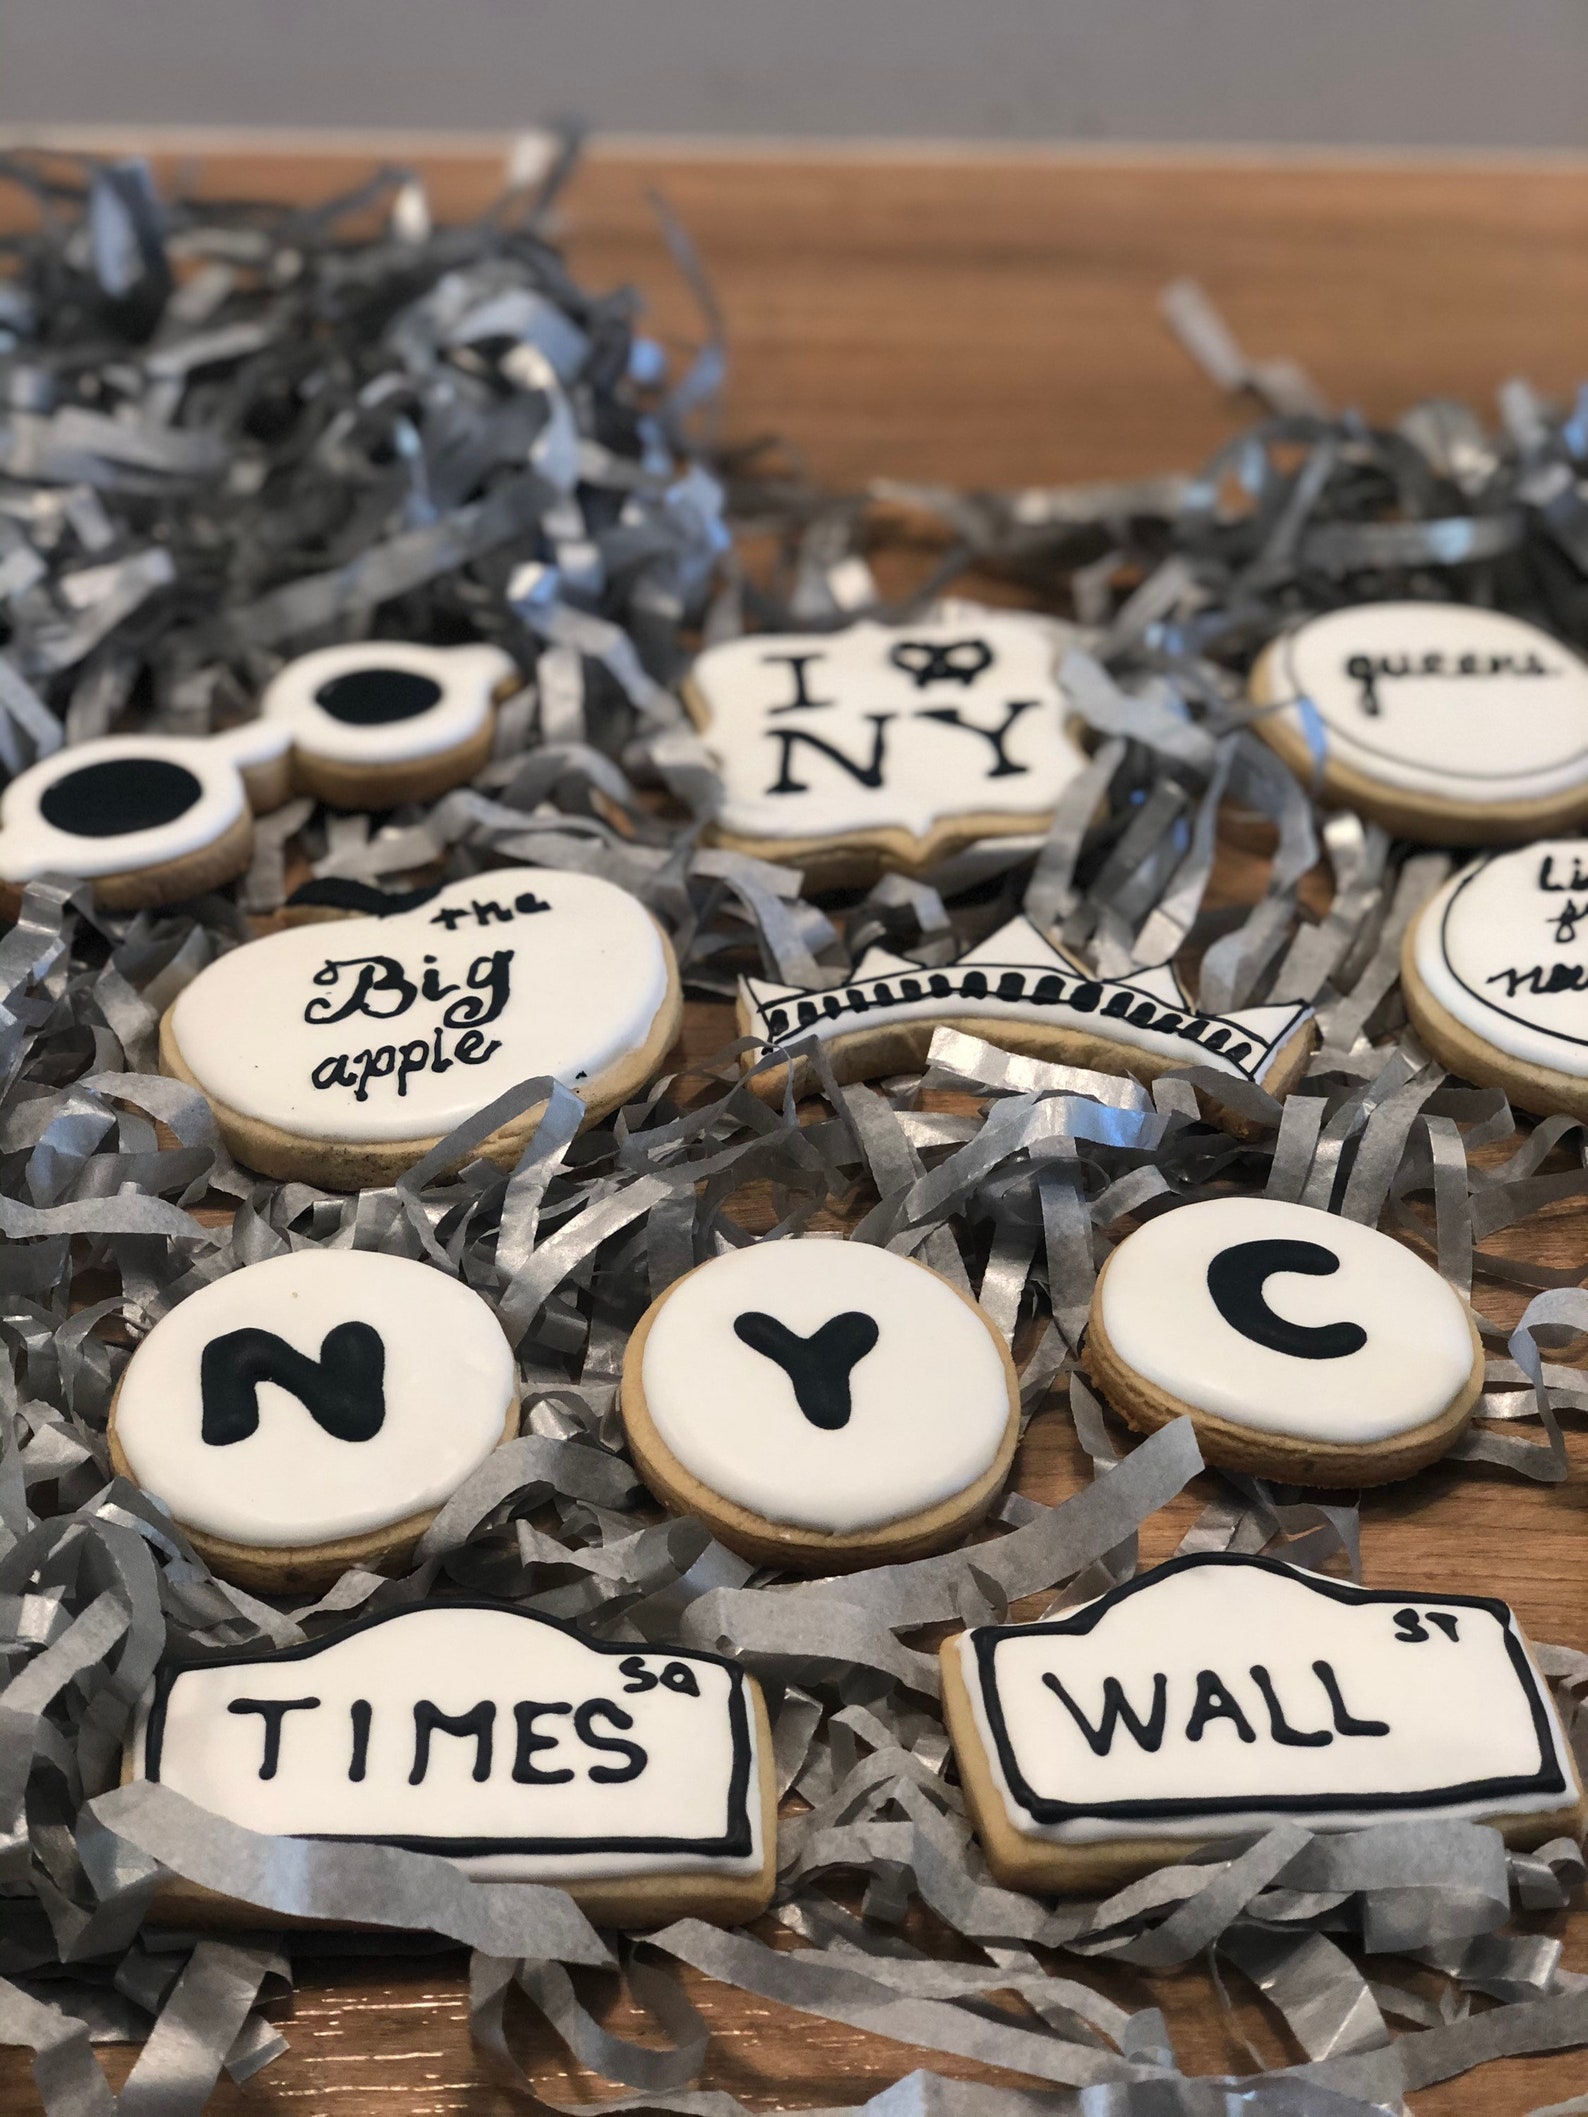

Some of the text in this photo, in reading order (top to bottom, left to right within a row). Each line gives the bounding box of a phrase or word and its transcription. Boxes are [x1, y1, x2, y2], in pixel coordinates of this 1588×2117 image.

[761, 652, 836, 716] I
[1344, 650, 1563, 718] queens
[763, 699, 1042, 796] NY
[429, 891, 552, 931] the
[303, 949, 515, 1029] Big
[310, 1026, 503, 1102] apple
[1392, 1607, 1461, 1644] ST
[226, 1697, 649, 1786] TIMES
[1041, 1659, 1391, 1757] WALL
